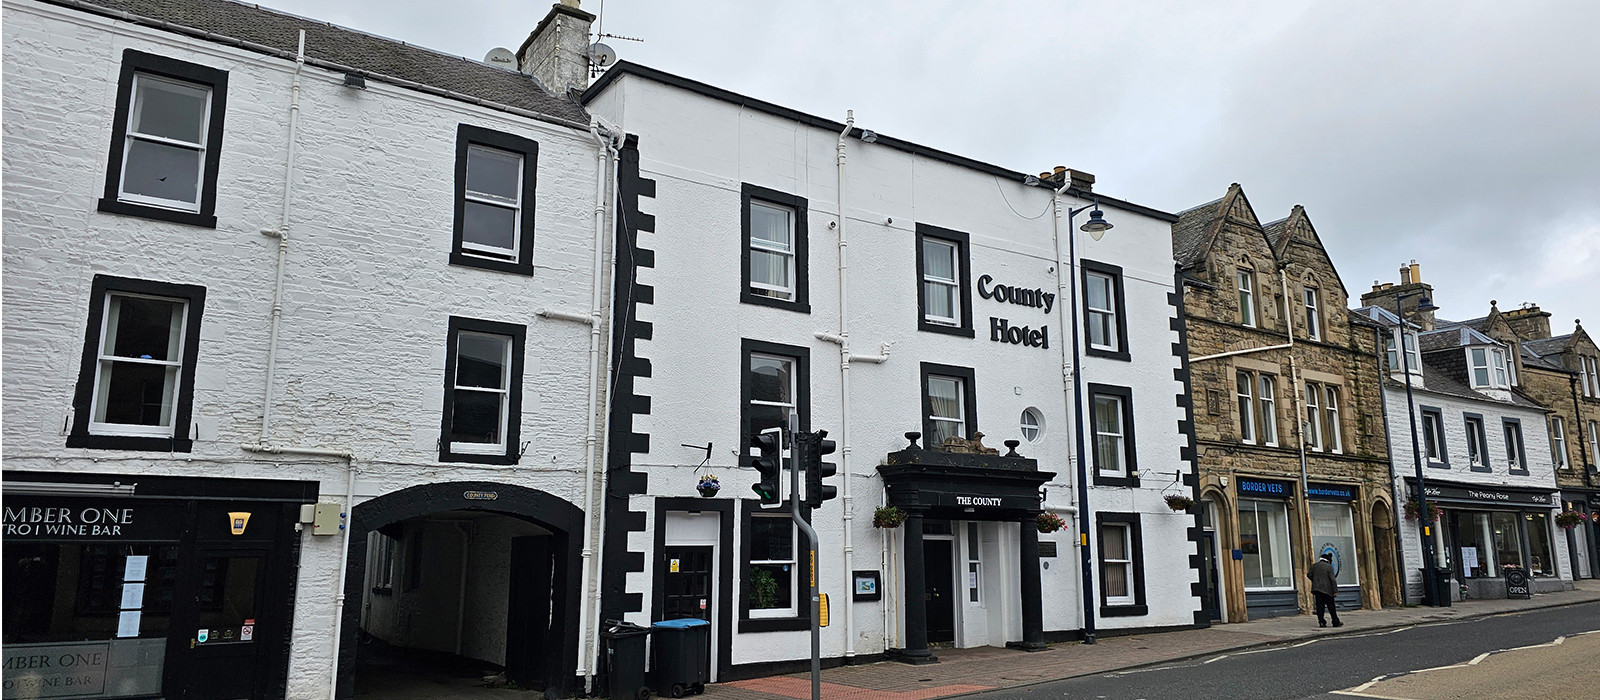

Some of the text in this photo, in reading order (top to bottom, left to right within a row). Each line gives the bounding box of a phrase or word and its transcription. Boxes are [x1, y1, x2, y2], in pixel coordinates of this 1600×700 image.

[977, 274, 1056, 315] County
[989, 316, 1050, 350] Hotel
[1242, 481, 1283, 493] BORDER VETS
[956, 496, 1002, 506] THE COUNTY
[1468, 490, 1479, 498] The
[1479, 491, 1496, 500] Peony
[80, 508, 133, 524] ONE
[45, 524, 88, 536] WINE
[91, 525, 121, 536] BAR
[1509, 586, 1527, 594] OPEN
[59, 652, 101, 668] ONE
[65, 676, 92, 687] BAR
